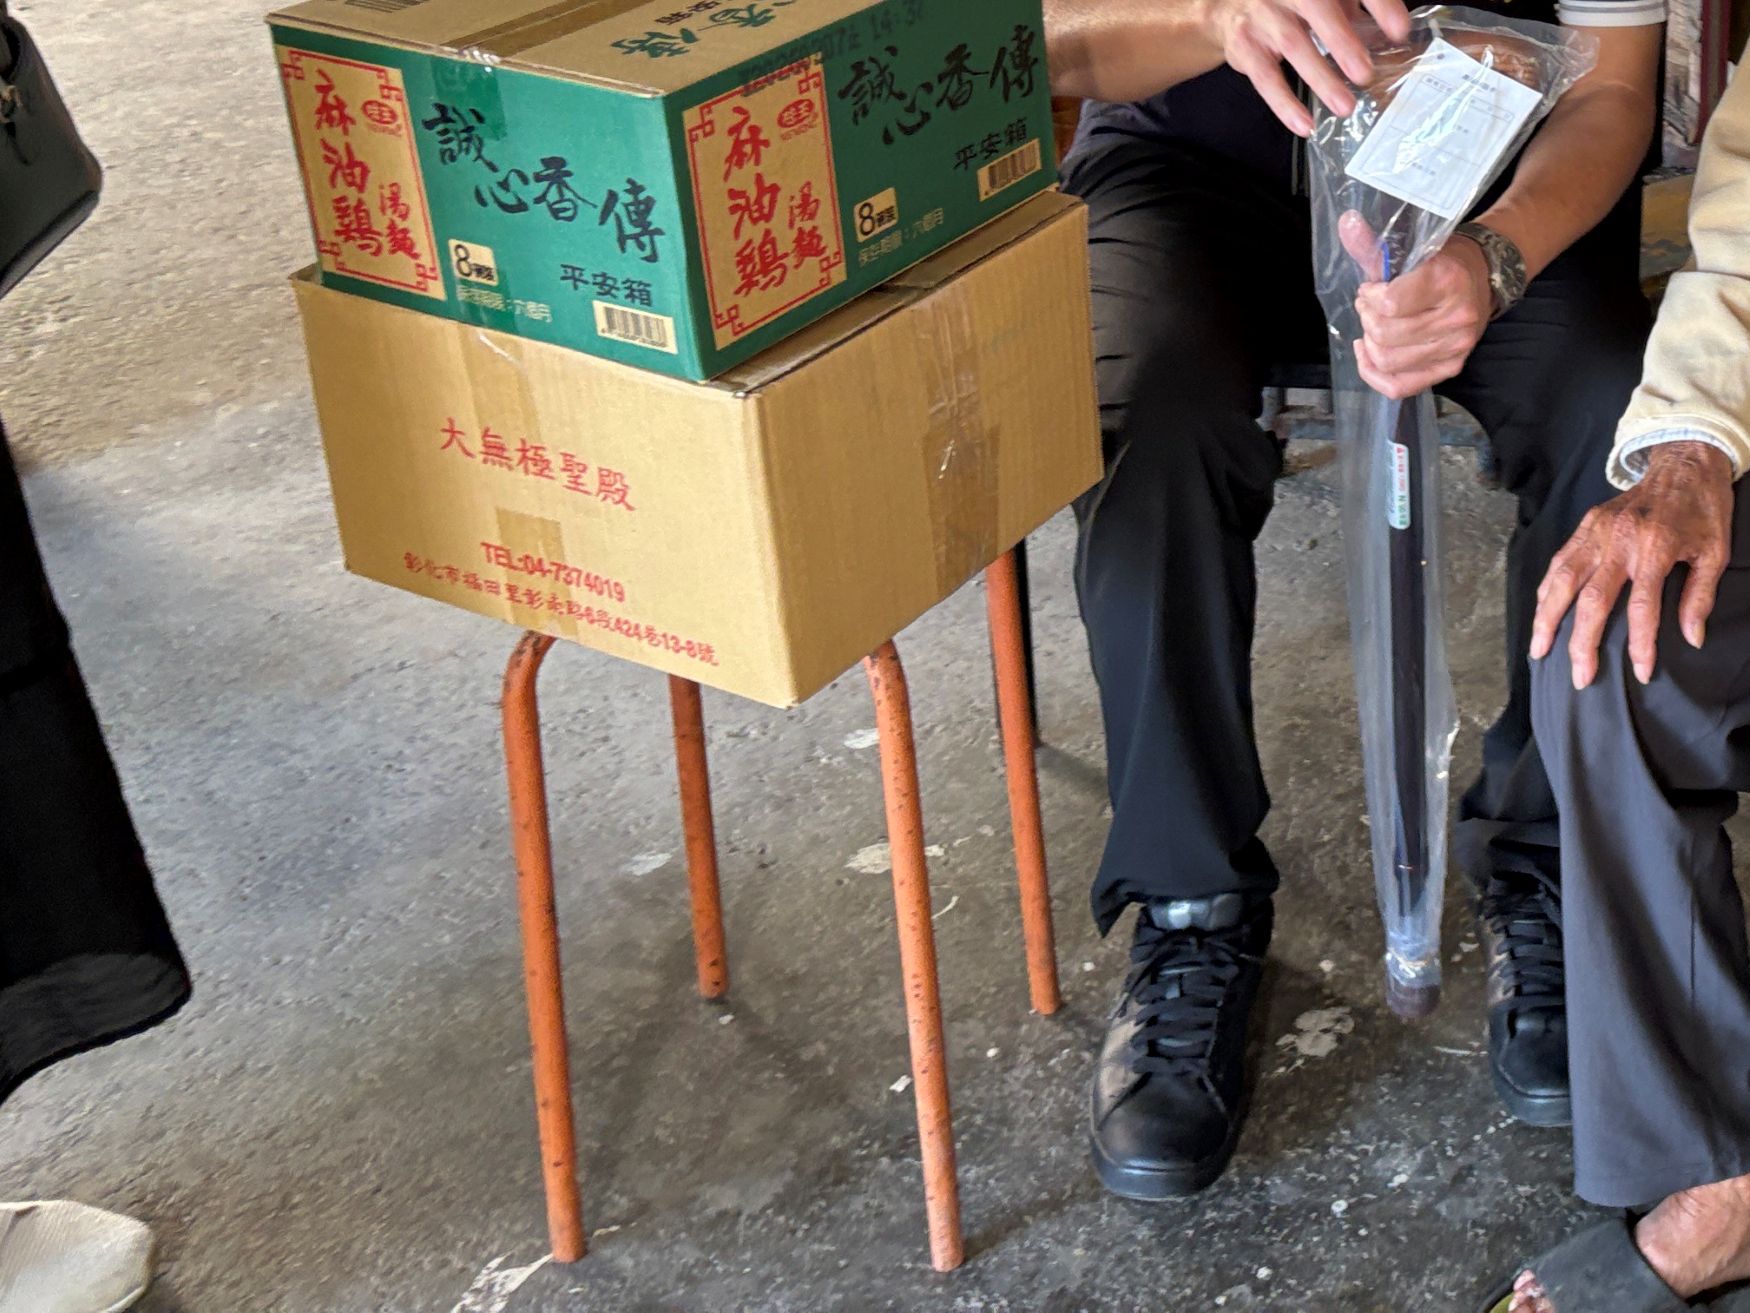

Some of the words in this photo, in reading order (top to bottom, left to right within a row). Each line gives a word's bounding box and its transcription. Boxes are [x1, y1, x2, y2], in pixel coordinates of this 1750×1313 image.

[837, 24, 1039, 146] 誠心香傳
[422, 102, 666, 264] 誠心香傳
[953, 117, 1028, 171] 平安箱
[560, 264, 653, 307] 平安箱
[440, 417, 636, 512] 大無極聖殿
